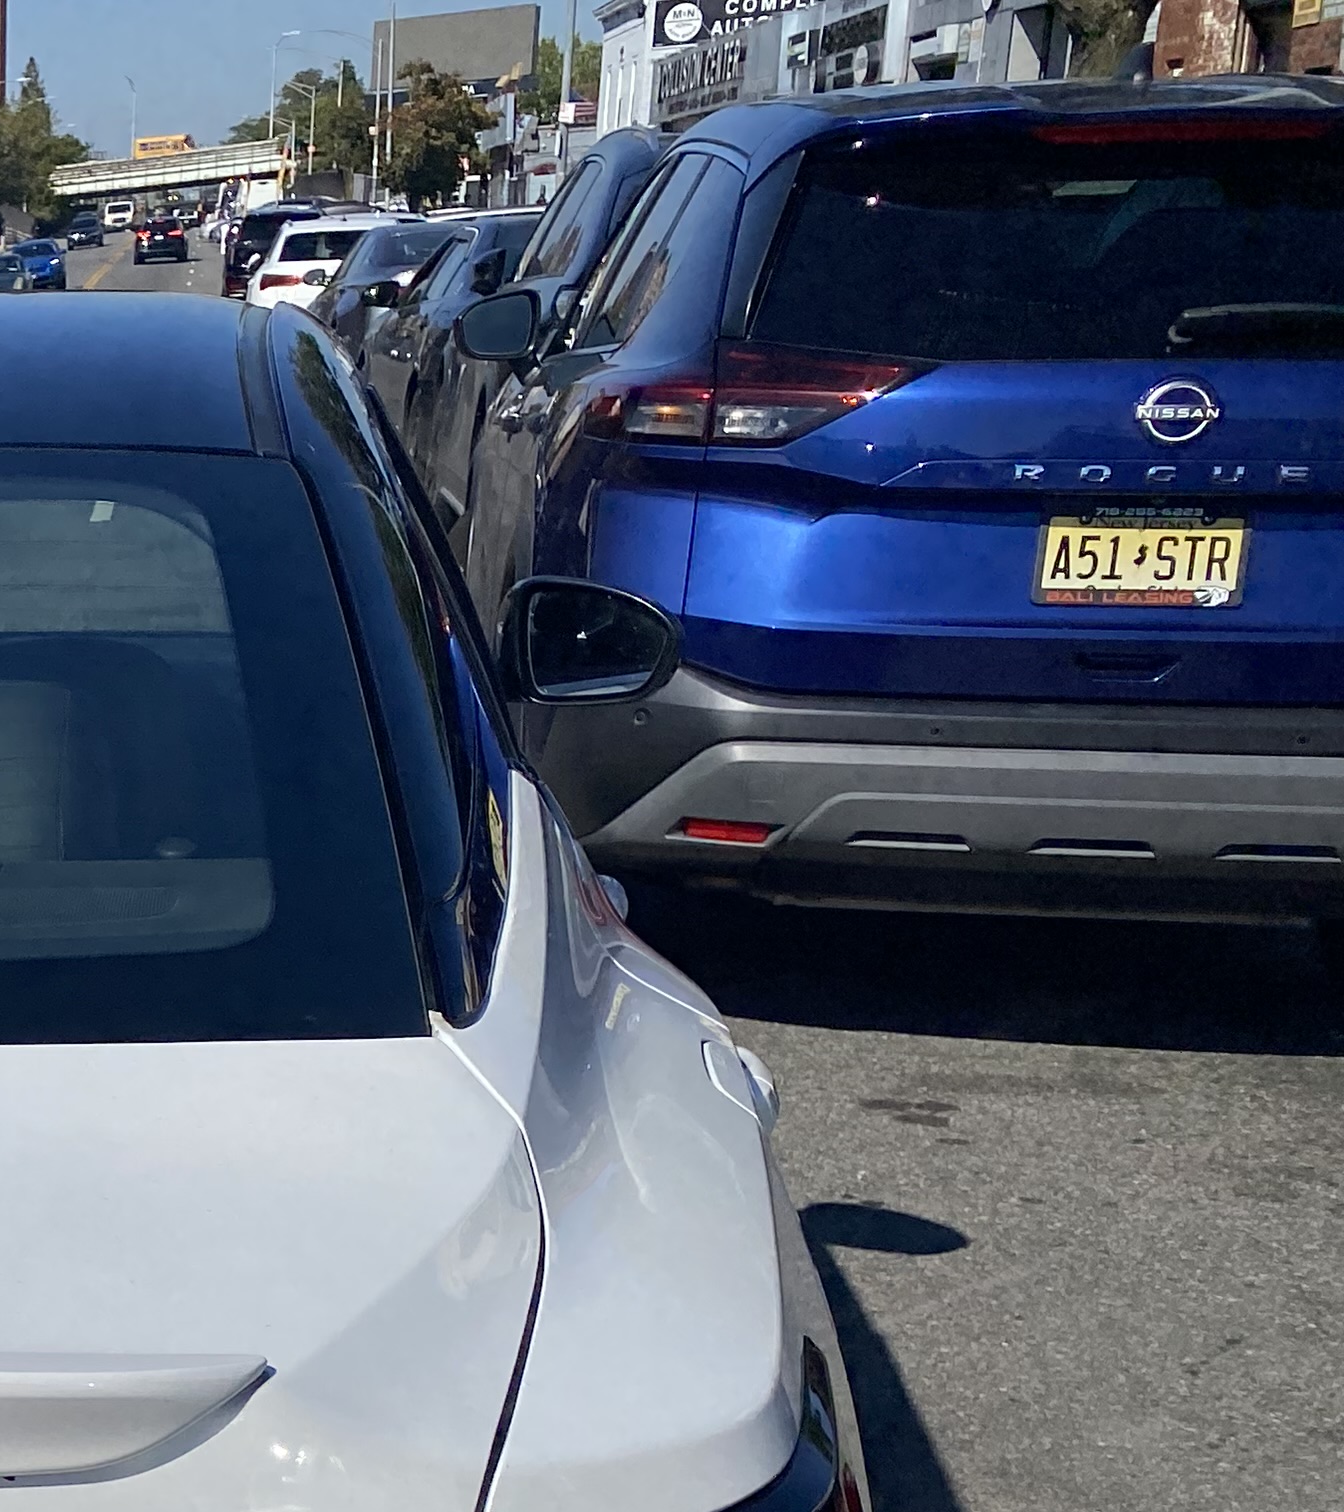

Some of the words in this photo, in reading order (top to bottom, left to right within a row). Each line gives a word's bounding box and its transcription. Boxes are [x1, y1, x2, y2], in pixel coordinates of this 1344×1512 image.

[1136, 407, 1220, 419] NISSAN
[1013, 463, 1310, 483] ROGUE
[1050, 535, 1123, 580] A51
[1153, 536, 1232, 581] STR
[1045, 592, 1093, 604] BALI
[1102, 592, 1193, 604] LEASING
